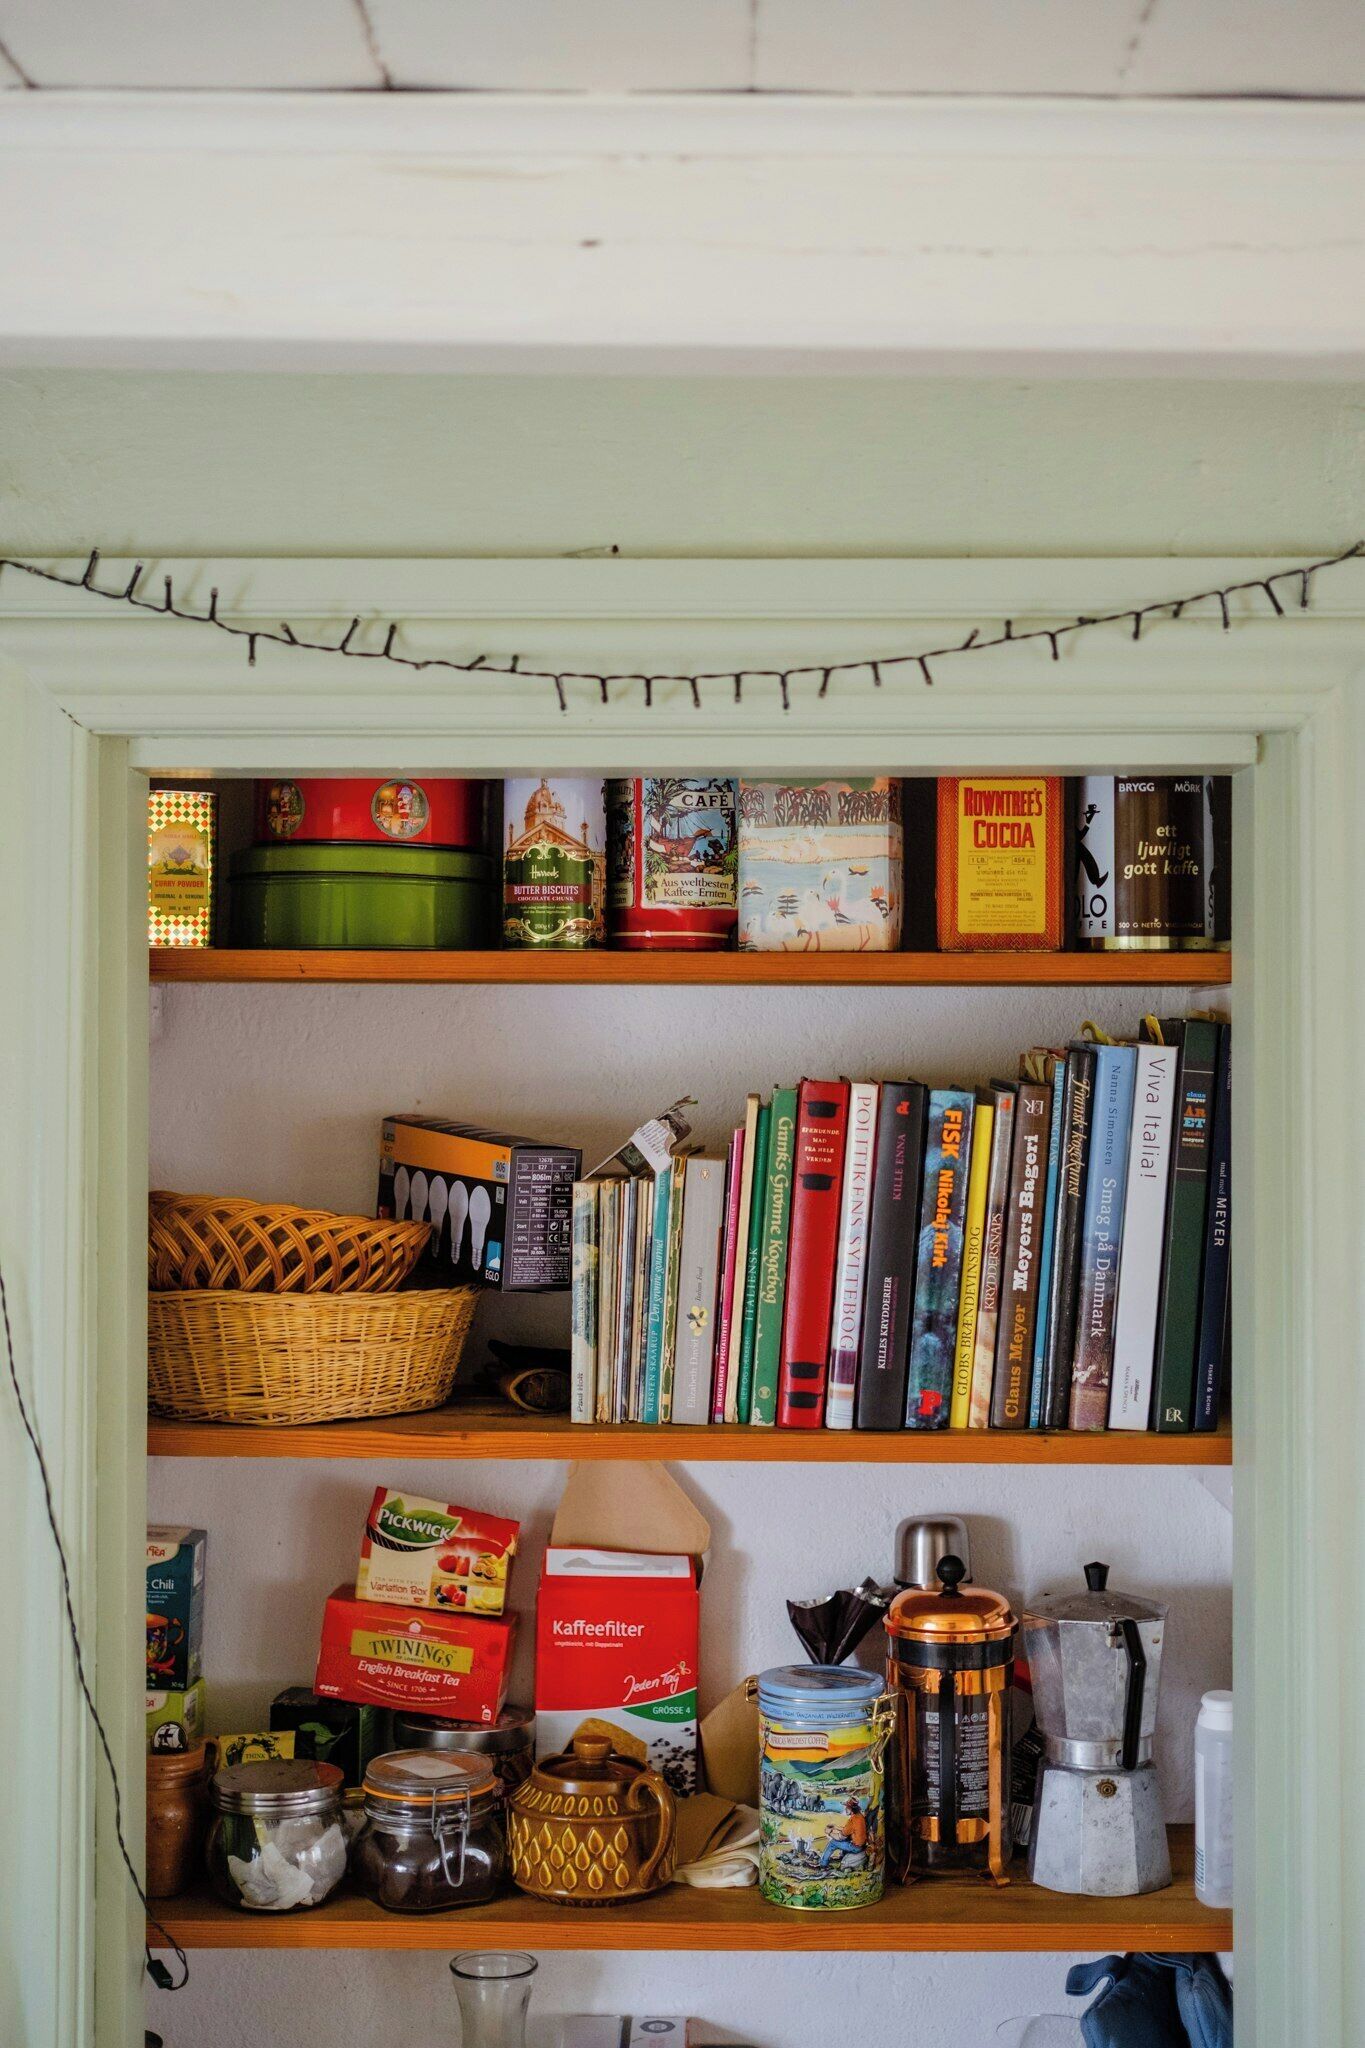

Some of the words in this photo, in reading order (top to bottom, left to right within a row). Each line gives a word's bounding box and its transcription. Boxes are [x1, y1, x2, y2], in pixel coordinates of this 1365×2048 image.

[681, 791, 729, 807] CAFÉ
[963, 786, 1042, 817] ROWNTREE'S
[1118, 782, 1155, 793] BRYGG
[1174, 780, 1201, 793] MÖRK
[973, 819, 1036, 848] COCOA
[1156, 824, 1178, 837] ett
[1137, 841, 1191, 860] ljuvligt
[154, 880, 176, 888] CURRY
[177, 880, 205, 888] POWDER
[529, 864, 559, 879] Harrods
[660, 879, 679, 888] Aus
[681, 877, 729, 889] weltbesten
[1123, 862, 1157, 880] gott
[1163, 860, 1199, 875] kaffe
[513, 885, 540, 895] BUTTER
[542, 885, 579, 895] BISCUITS
[663, 887, 727, 899] Kaffee-Ernten
[1055, 1068, 1064, 1090] THAI
[1110, 1065, 1121, 1103] Nanna
[1145, 1058, 1167, 1103] Viva
[1052, 1091, 1063, 1136] COOKING
[1071, 1073, 1091, 1127] Fransk
[895, 1133, 906, 1165] ENNA
[940, 1108, 964, 1160] FISK
[1050, 1136, 1059, 1166] CLASS
[1104, 1107, 1118, 1165] Simonsen
[1140, 1115, 1162, 1178] Italia!
[531, 1173, 552, 1181] 806lm
[850, 1095, 872, 1227] POLITIKENS
[1018, 1134, 1039, 1209] Bageri
[1063, 1131, 1087, 1198] kogekunst
[892, 1166, 904, 1201] KILLE
[932, 1168, 955, 1229] Nikolaj
[769, 1174, 789, 1236] Grønne
[1095, 1177, 1117, 1225] Smag
[1213, 1197, 1228, 1247] MEYER
[931, 1231, 949, 1268] Kirk
[1012, 1212, 1034, 1292] Meyers
[1094, 1231, 1114, 1252] på
[485, 1269, 500, 1282] EGLO
[984, 1212, 1002, 1310] KRYDDERSNAPS
[745, 1247, 758, 1321] ITALIENSK
[839, 1236, 861, 1350] SYLTEBOG
[960, 1227, 981, 1348] BRÆNDEVINSBOG
[1090, 1258, 1111, 1338] Danmark
[650, 1305, 661, 1323] Den
[879, 1276, 893, 1333] KRYDDERIER
[1008, 1304, 1027, 1362] Meyer
[649, 1330, 659, 1372] SKAARUP
[689, 1339, 700, 1366] David
[877, 1336, 888, 1370] KILLES
[646, 1374, 656, 1412] KIRSTEN
[686, 1368, 698, 1409] Elizabeth
[717, 1365, 727, 1408] MEXICANSKE
[956, 1355, 970, 1397] GLOBS
[1004, 1365, 1022, 1418] Claus
[1032, 1377, 1041, 1405] BOOKS
[377, 1508, 451, 1541] PICKWICK
[151, 1578, 175, 1590] Chili
[370, 1581, 408, 1593] Variation
[409, 1585, 428, 1596] Box
[552, 1619, 645, 1637] Kaffeefilter
[368, 1638, 454, 1668] TWININGS
[357, 1659, 393, 1676] English
[393, 1664, 440, 1684] Breakfast
[442, 1673, 460, 1687] Tea
[386, 1680, 408, 1692] SINCE
[411, 1685, 428, 1694] 1706
[622, 1674, 660, 1703] Jeden
[660, 1668, 681, 1694] Tag
[652, 1705, 684, 1715] GRÖSSE
[685, 1706, 691, 1714] 4
[808, 1735, 827, 1745] COFFEE
